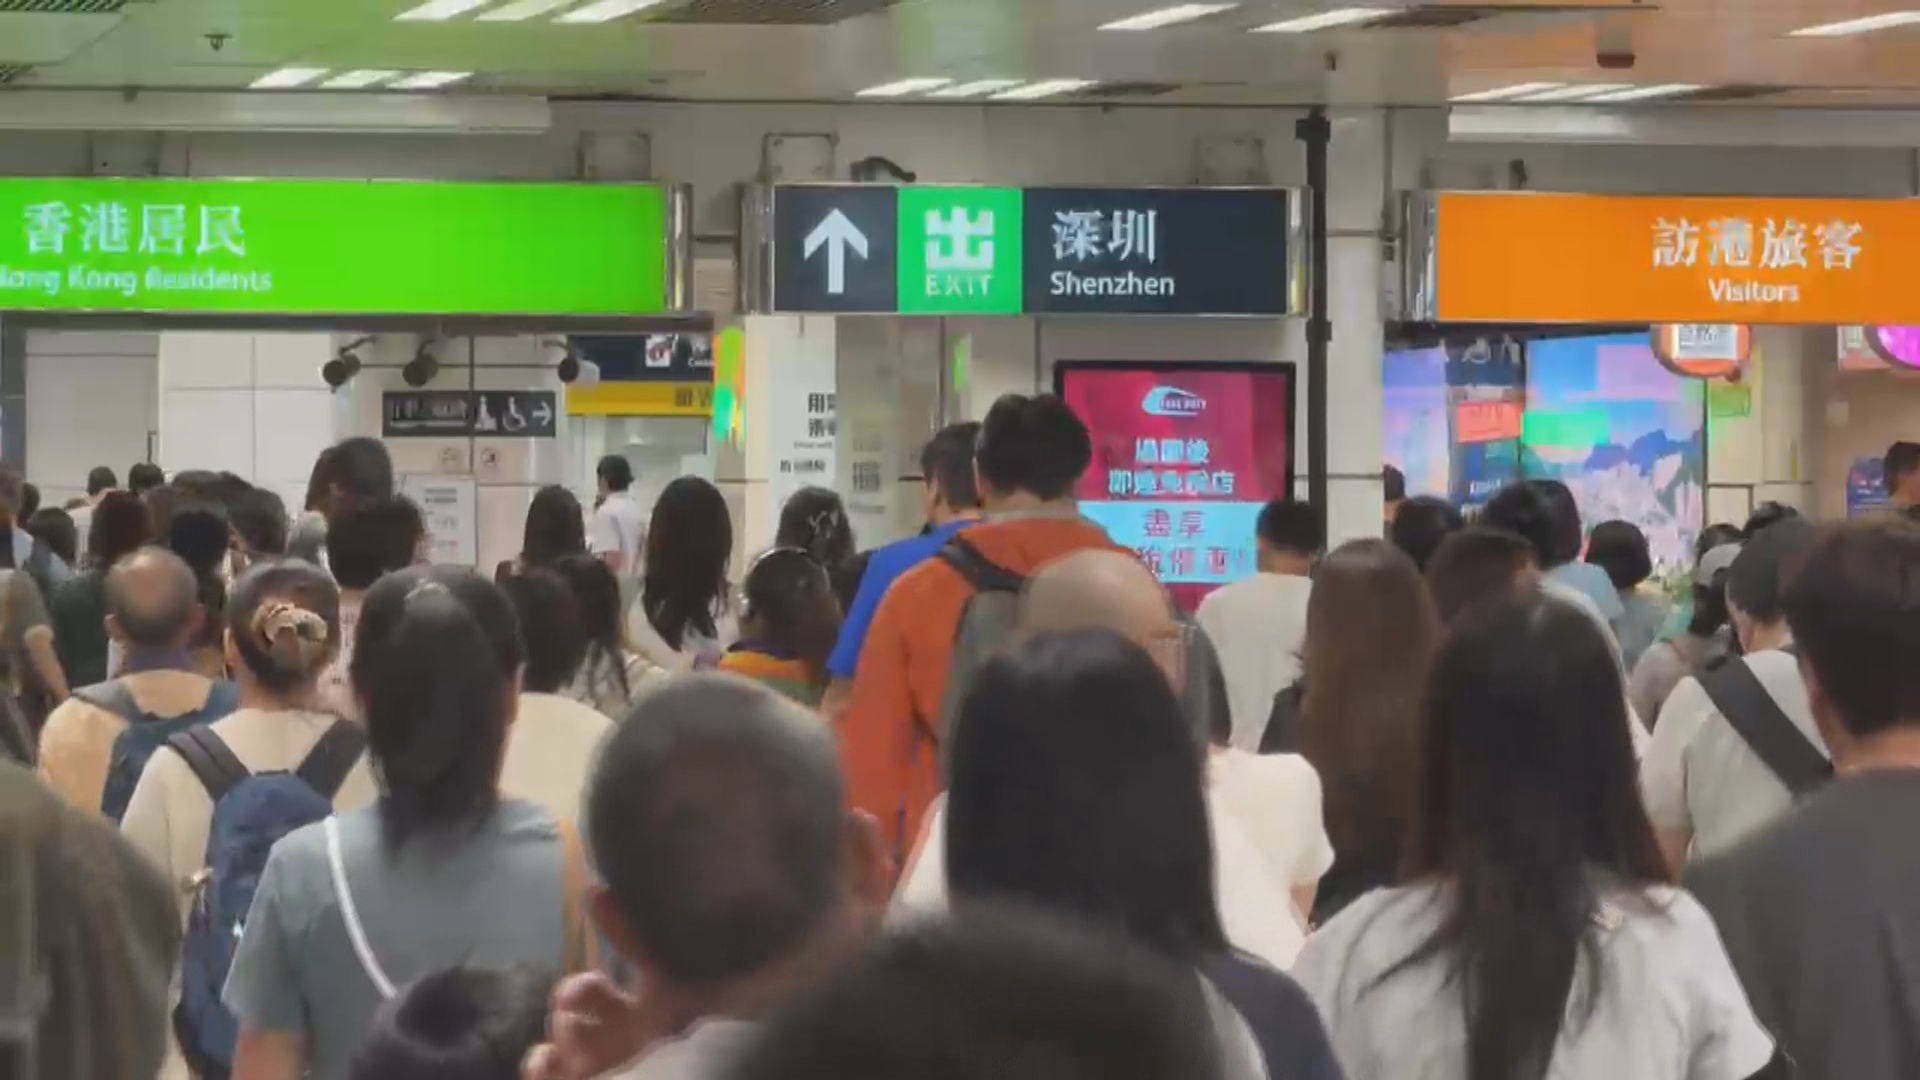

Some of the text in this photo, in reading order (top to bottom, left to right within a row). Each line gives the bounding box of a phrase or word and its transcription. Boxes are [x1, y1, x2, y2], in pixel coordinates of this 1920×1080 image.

[24, 202, 246, 255] 香港居民
[925, 207, 994, 270] 出
[1052, 210, 1157, 264] 深圳
[1650, 217, 1863, 269] 訪港旅客
[68, 264, 138, 296] Kong
[145, 266, 272, 292] Residents
[925, 274, 992, 296] EXIT
[1050, 270, 1175, 296] Shenzhen
[1708, 278, 1799, 302] Visitors
